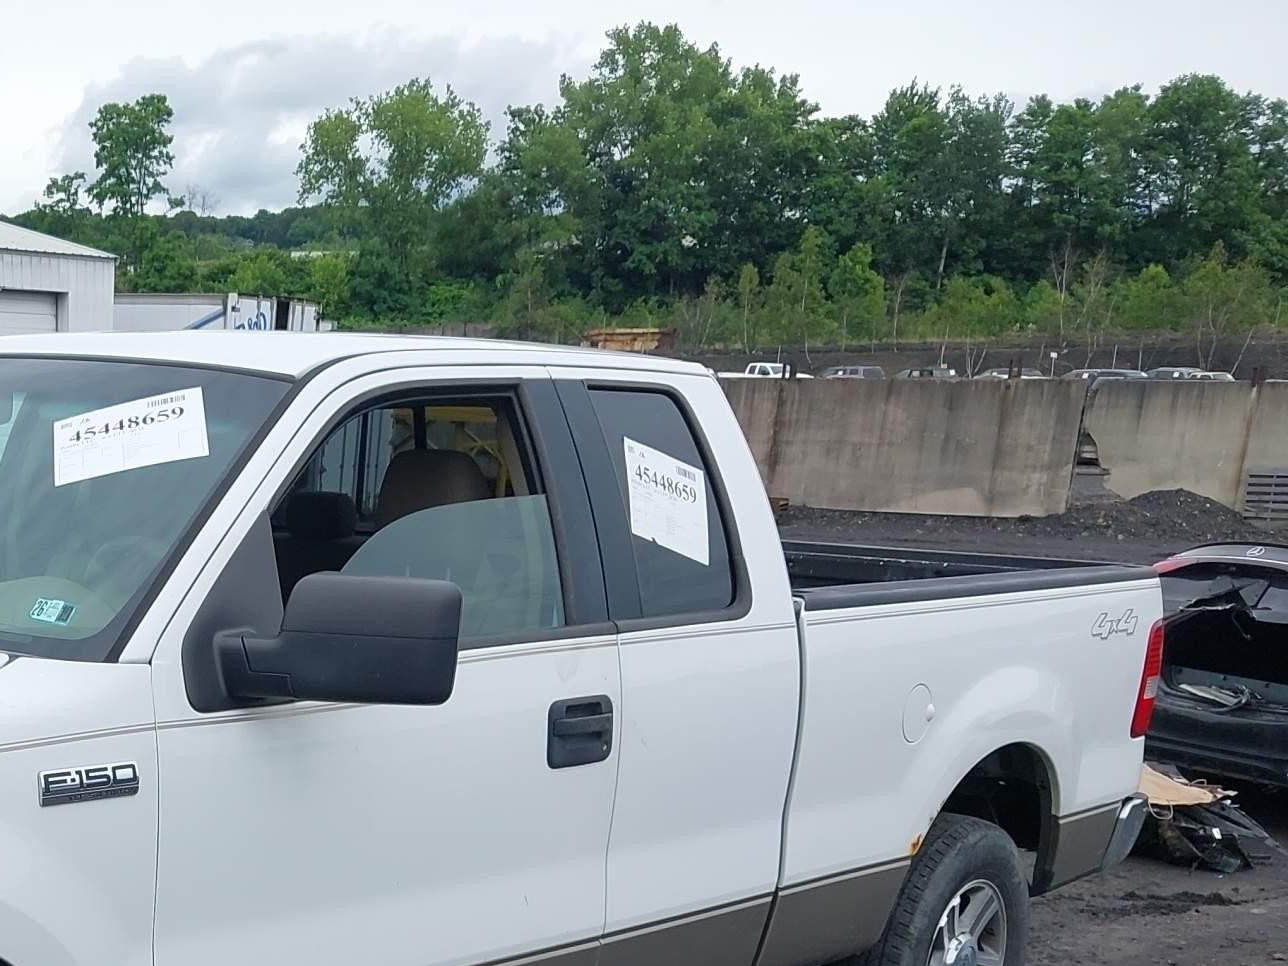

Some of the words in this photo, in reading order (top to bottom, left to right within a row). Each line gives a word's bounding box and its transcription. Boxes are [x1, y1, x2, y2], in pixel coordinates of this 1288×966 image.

[69, 407, 185, 442] 45448659
[635, 463, 697, 504] 45448659
[1091, 608, 1139, 640] 4x4
[43, 763, 139, 793] F-150
